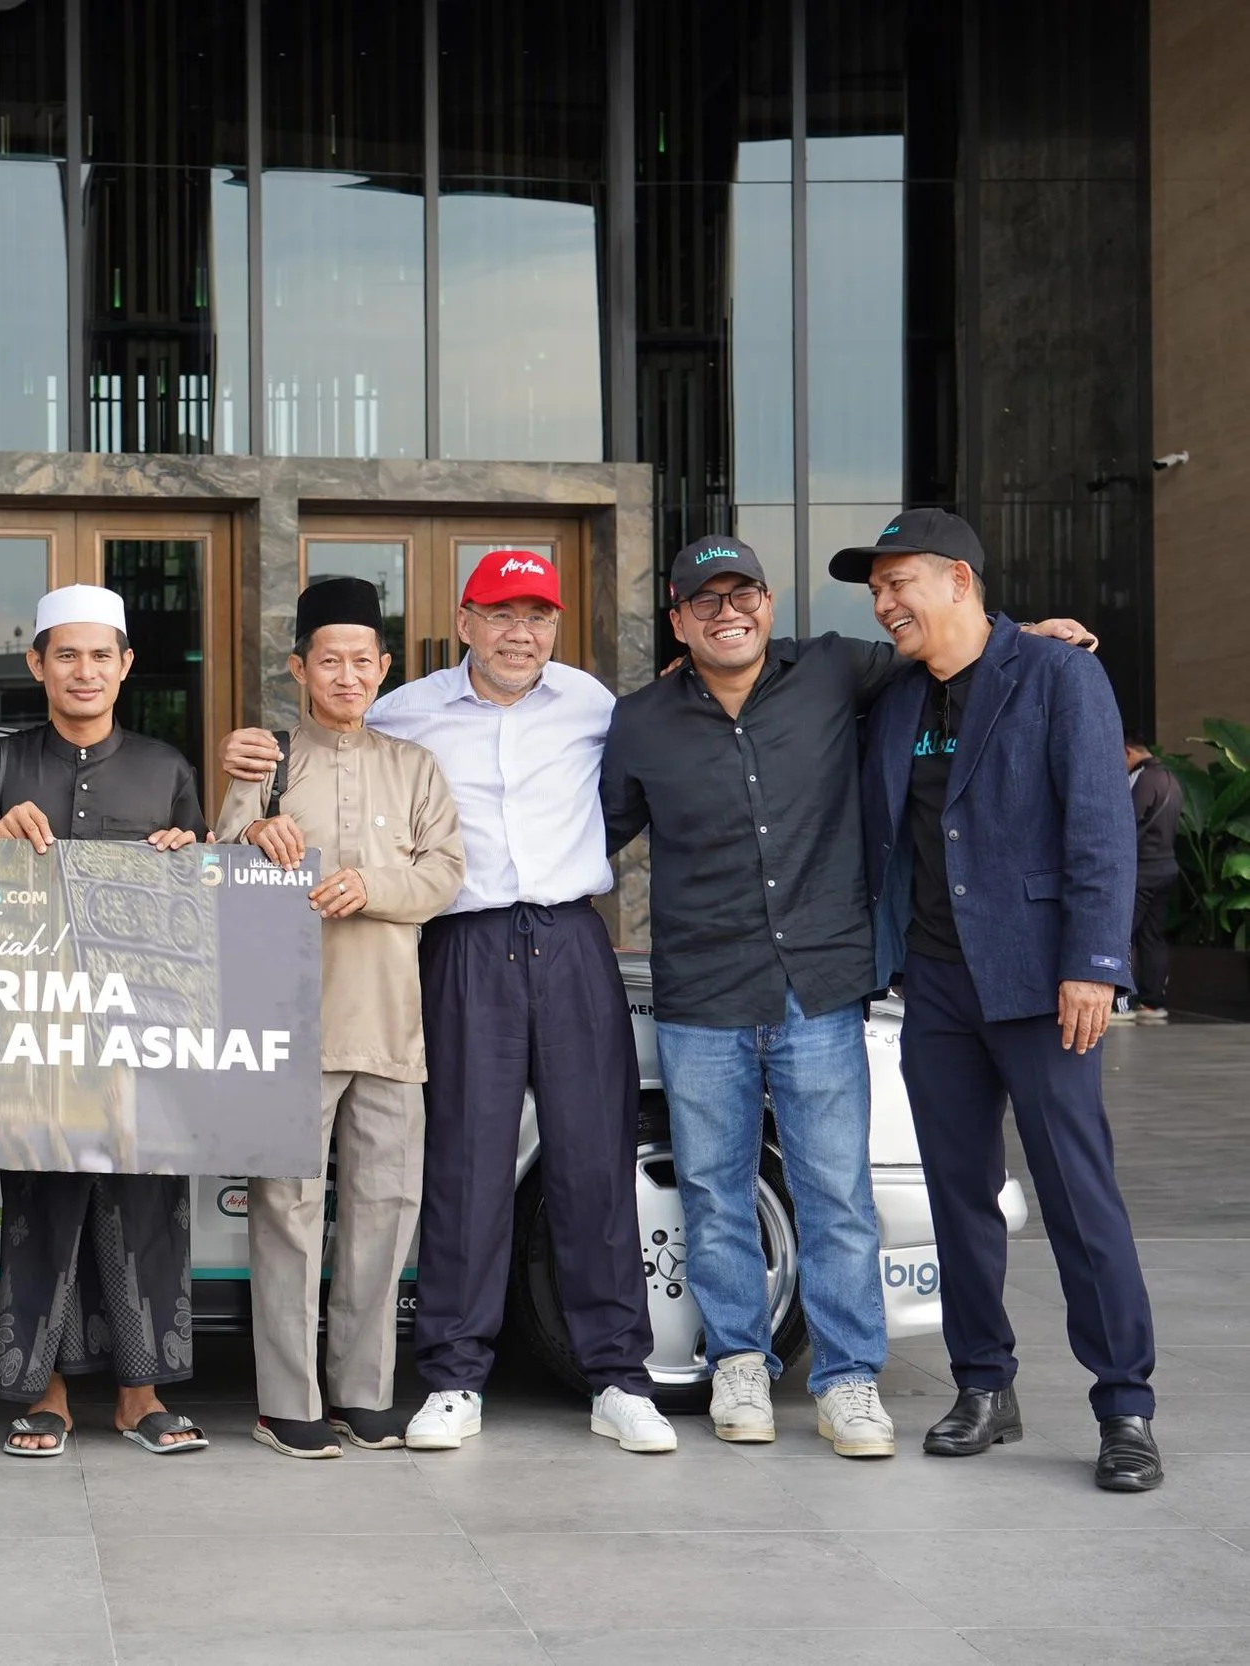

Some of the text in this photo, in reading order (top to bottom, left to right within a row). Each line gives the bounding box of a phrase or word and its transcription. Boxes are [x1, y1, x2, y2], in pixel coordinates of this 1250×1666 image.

[695, 546, 739, 565] ikhlas
[500, 557, 545, 577] AirAsia
[234, 868, 313, 886] UMRAH
[98, 1025, 290, 1072] ASNAF
[884, 1256, 939, 1295] big
